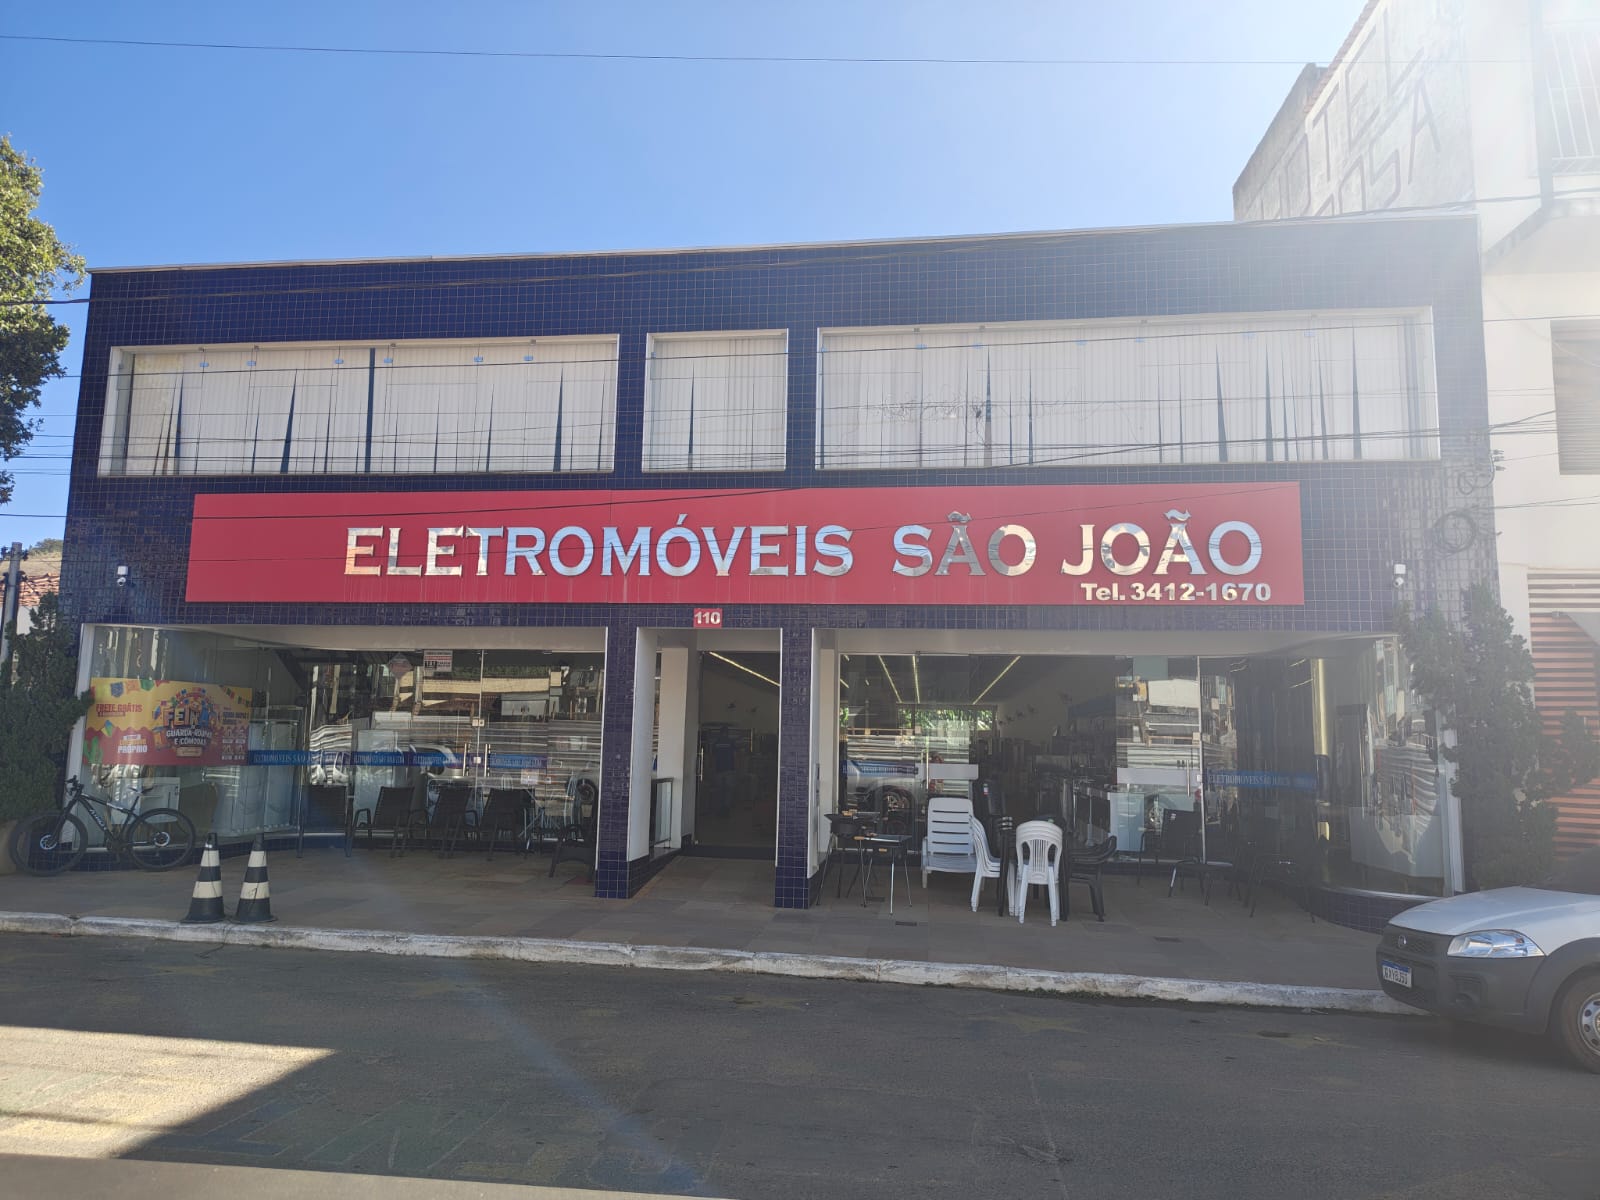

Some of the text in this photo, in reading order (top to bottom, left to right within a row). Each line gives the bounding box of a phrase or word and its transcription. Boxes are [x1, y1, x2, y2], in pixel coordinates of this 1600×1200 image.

[344, 508, 1263, 577] ELETROMÓVEIS SÃO JOÃO
[1130, 582, 1271, 601] 3412-1670
[694, 611, 721, 625] 110
